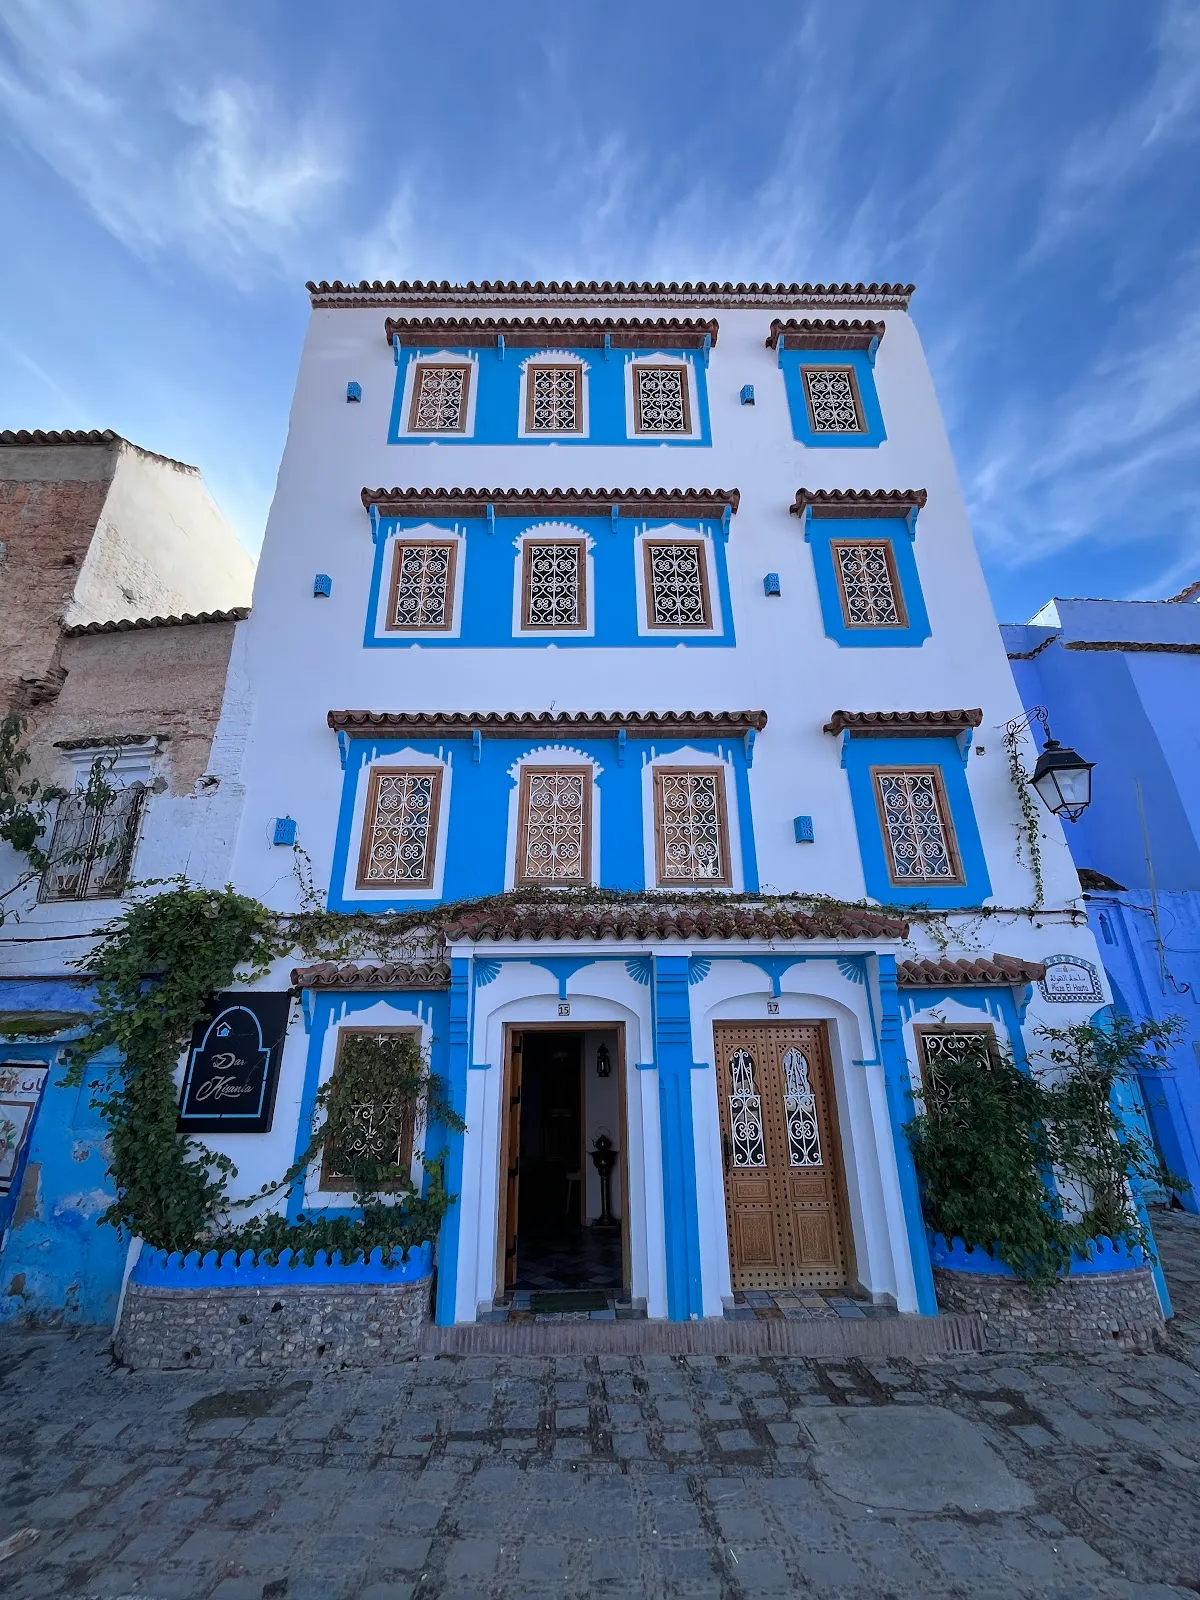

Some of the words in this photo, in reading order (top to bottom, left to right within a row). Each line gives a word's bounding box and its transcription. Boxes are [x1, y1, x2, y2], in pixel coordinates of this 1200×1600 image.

[1051, 983, 1065, 992] Plaza
[558, 1006, 569, 1014] 15
[768, 1004, 778, 1012] 17
[211, 1053, 247, 1069] Dar
[195, 1076, 254, 1101] Kisania
